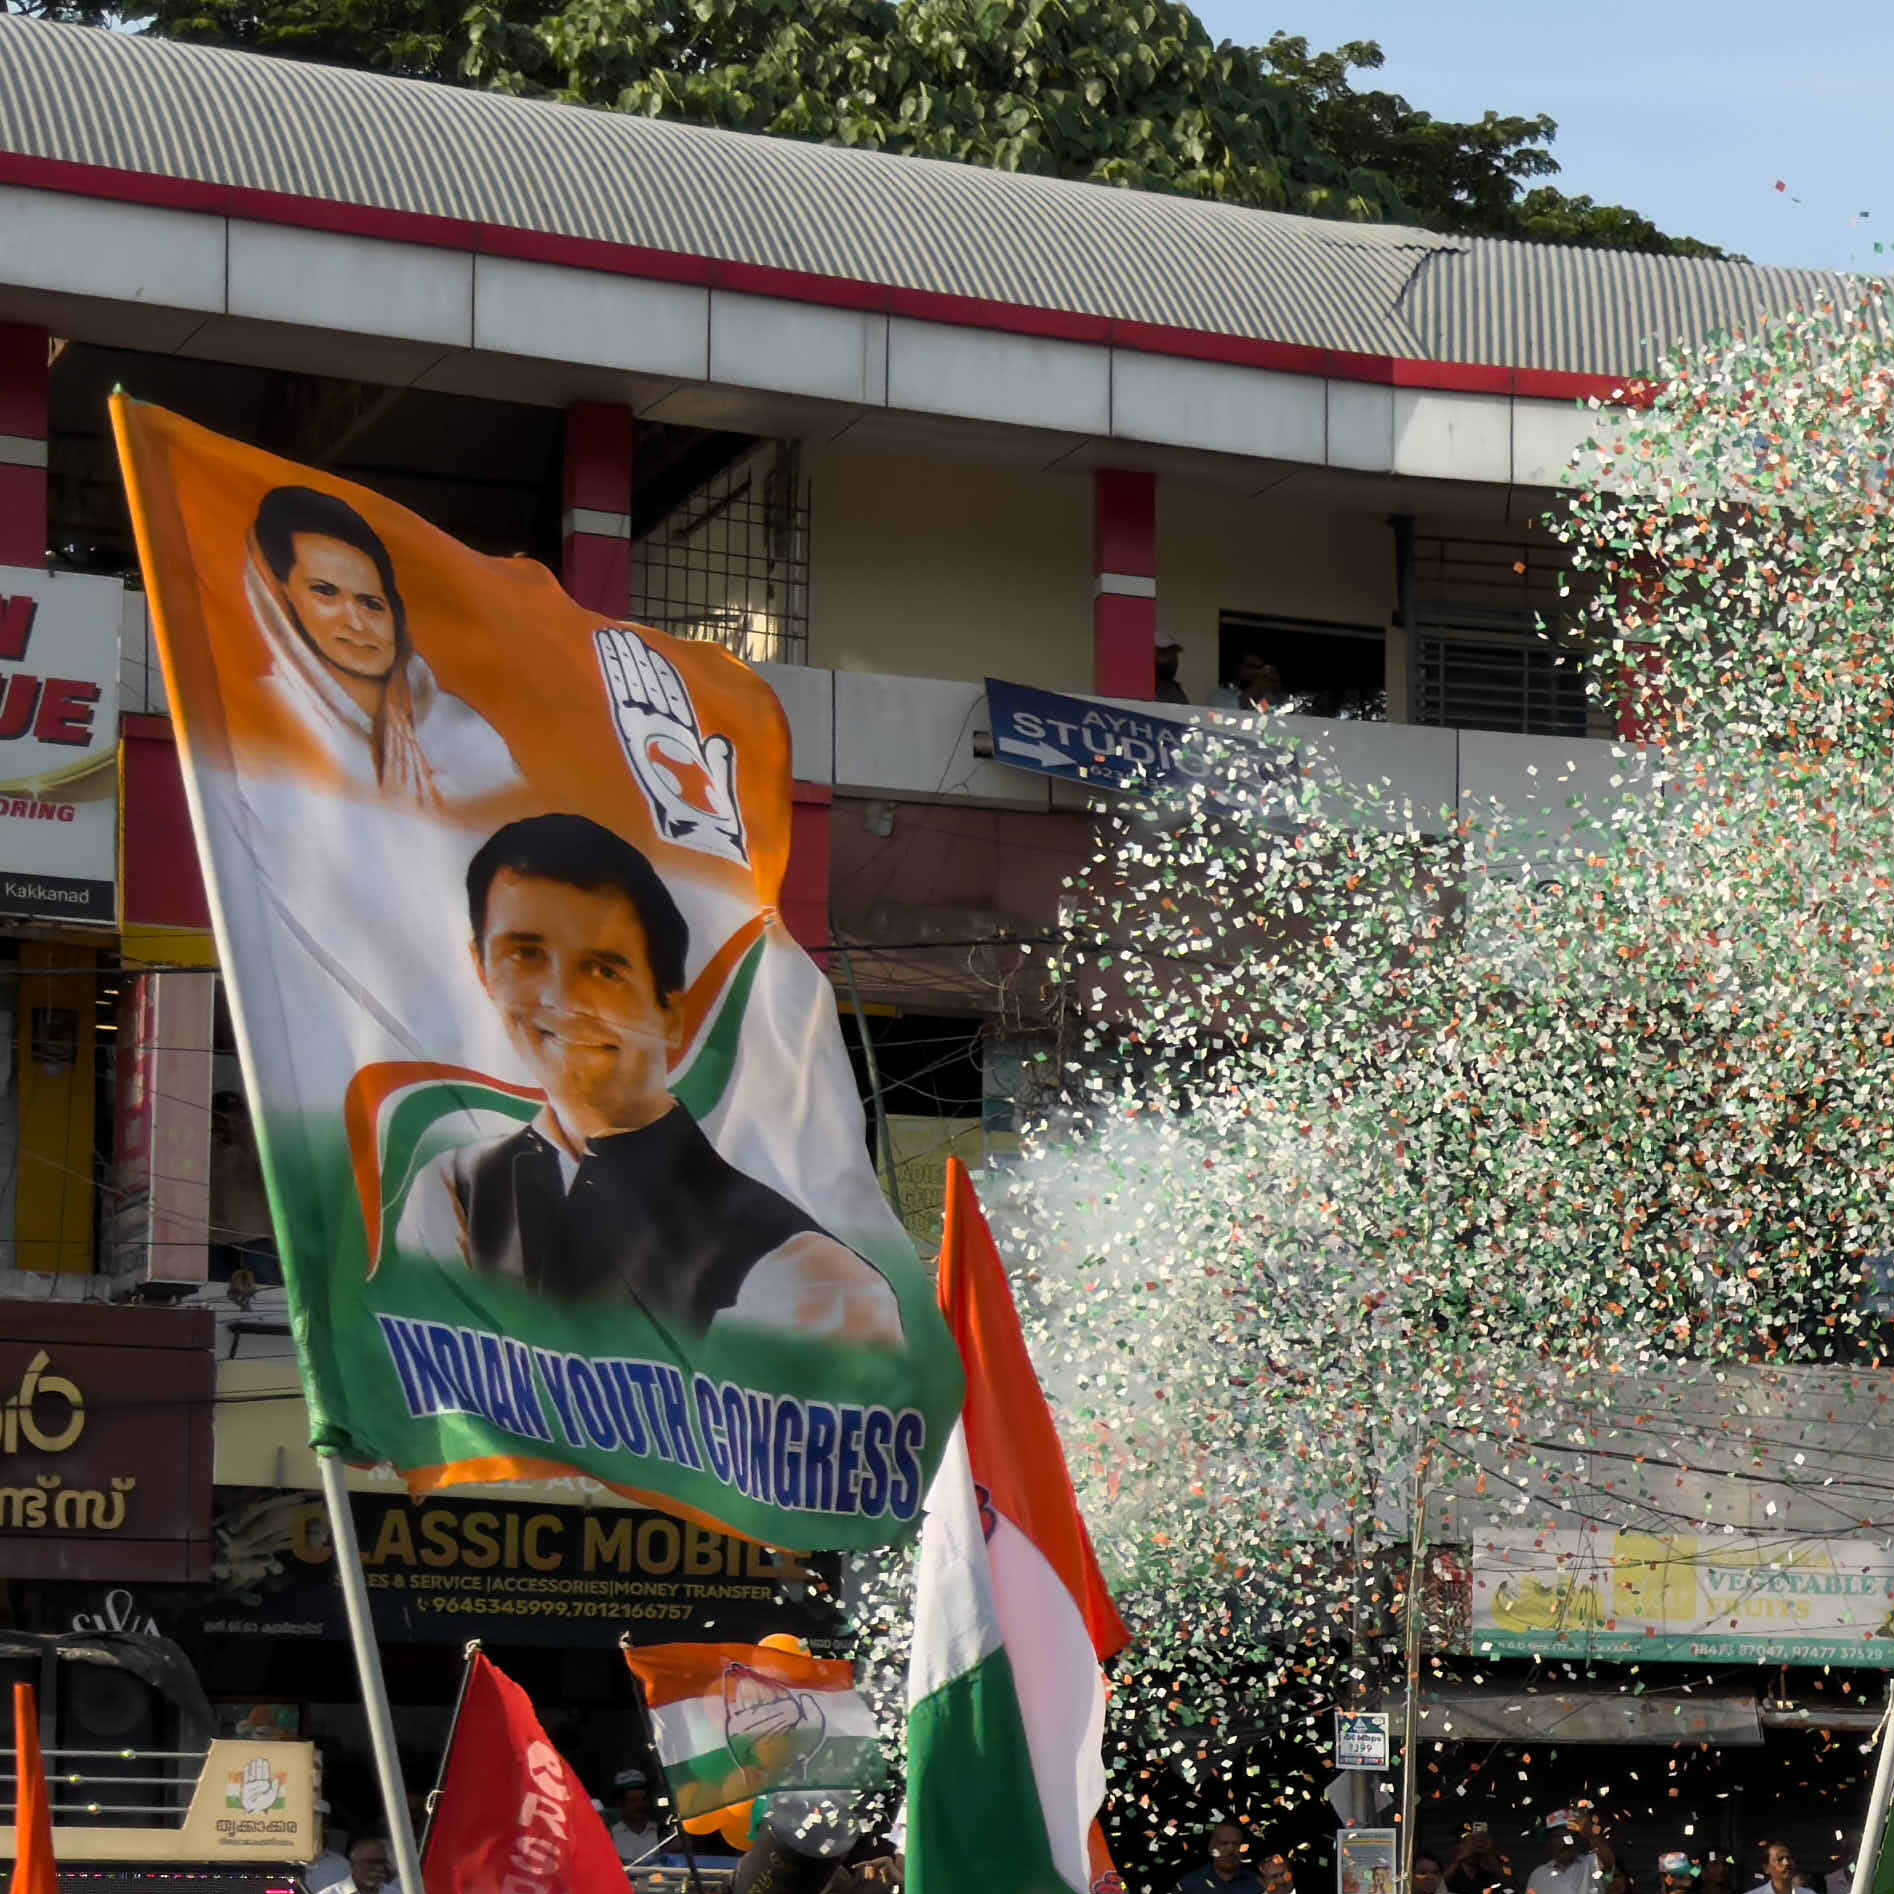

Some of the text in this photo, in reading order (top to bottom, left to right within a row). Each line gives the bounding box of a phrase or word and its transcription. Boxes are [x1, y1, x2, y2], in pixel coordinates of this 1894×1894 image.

[5, 881, 90, 905] Kakkanad
[376, 1312, 929, 1523] INDIAN YOUTH CONGRESS
[292, 1503, 566, 1573] CASSIC
[335, 1572, 388, 1590] SES
[410, 1574, 482, 1592] SERVICE
[682, 1582, 772, 1602] TRANSFER
